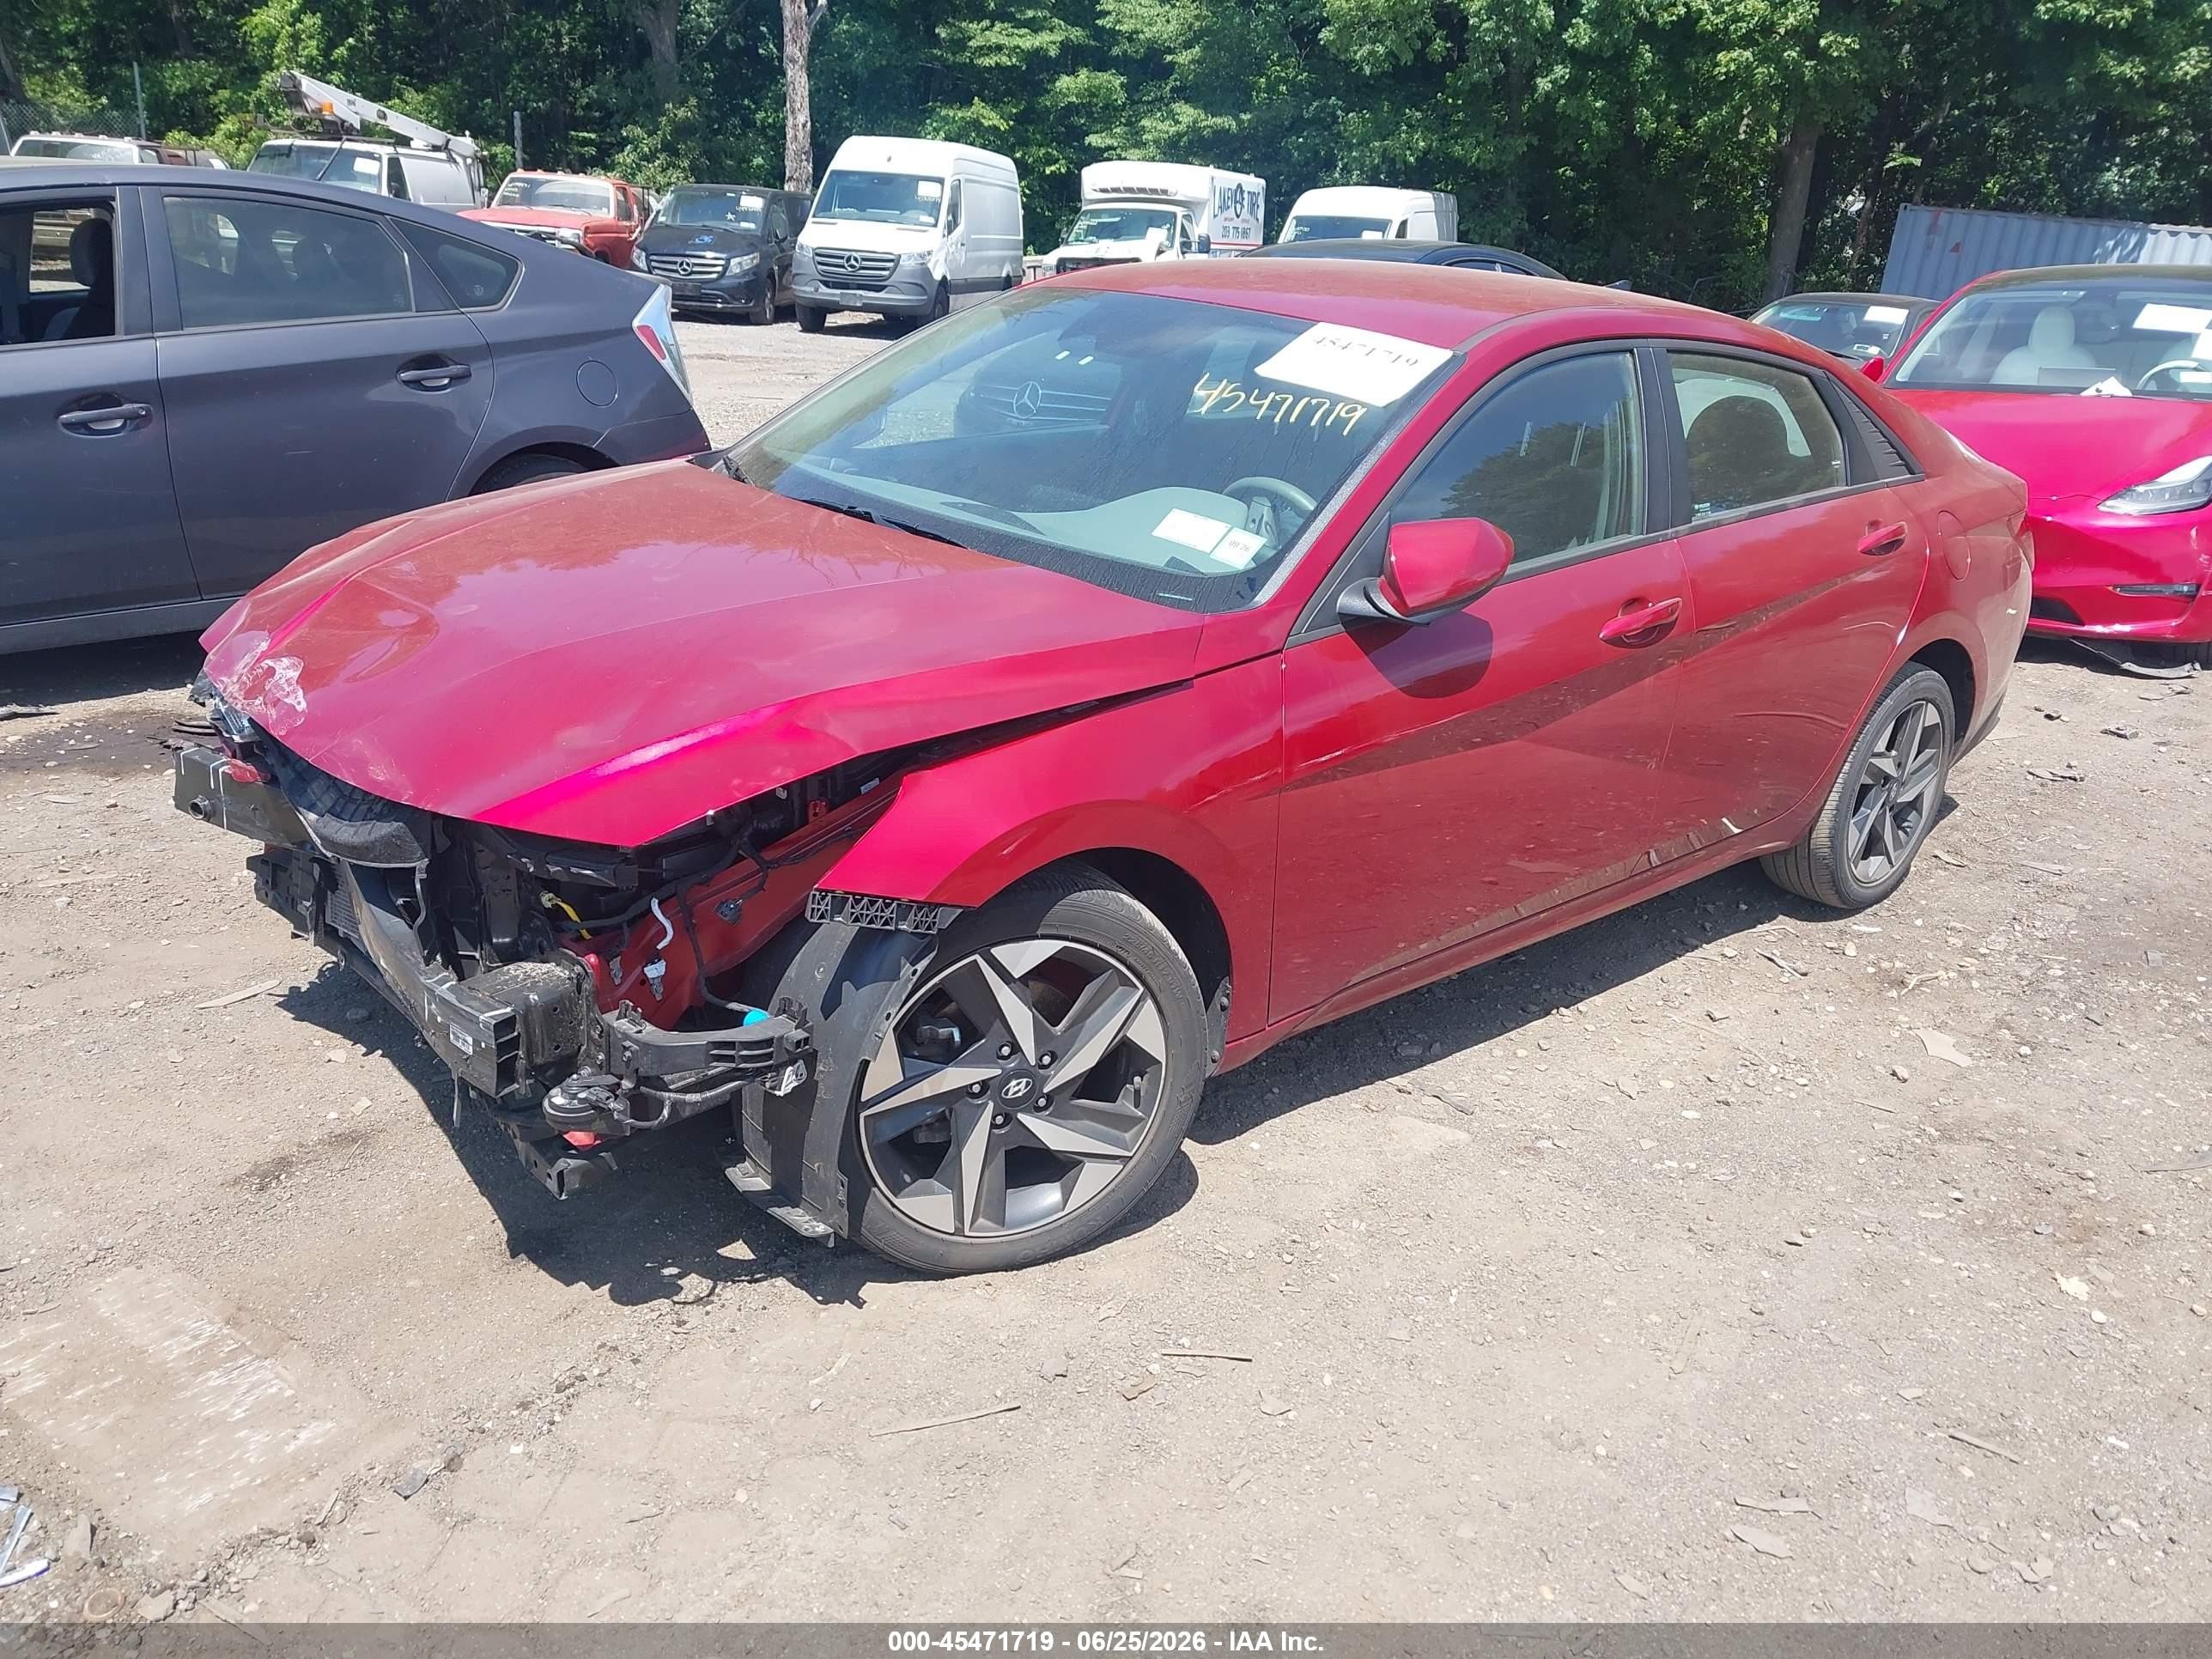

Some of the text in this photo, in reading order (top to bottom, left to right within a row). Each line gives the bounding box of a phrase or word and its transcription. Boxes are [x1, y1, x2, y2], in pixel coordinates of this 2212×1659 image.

[1247, 191, 1261, 223] TIRE
[1222, 225, 1231, 239] 203
[1194, 371, 1368, 436] 45471719
